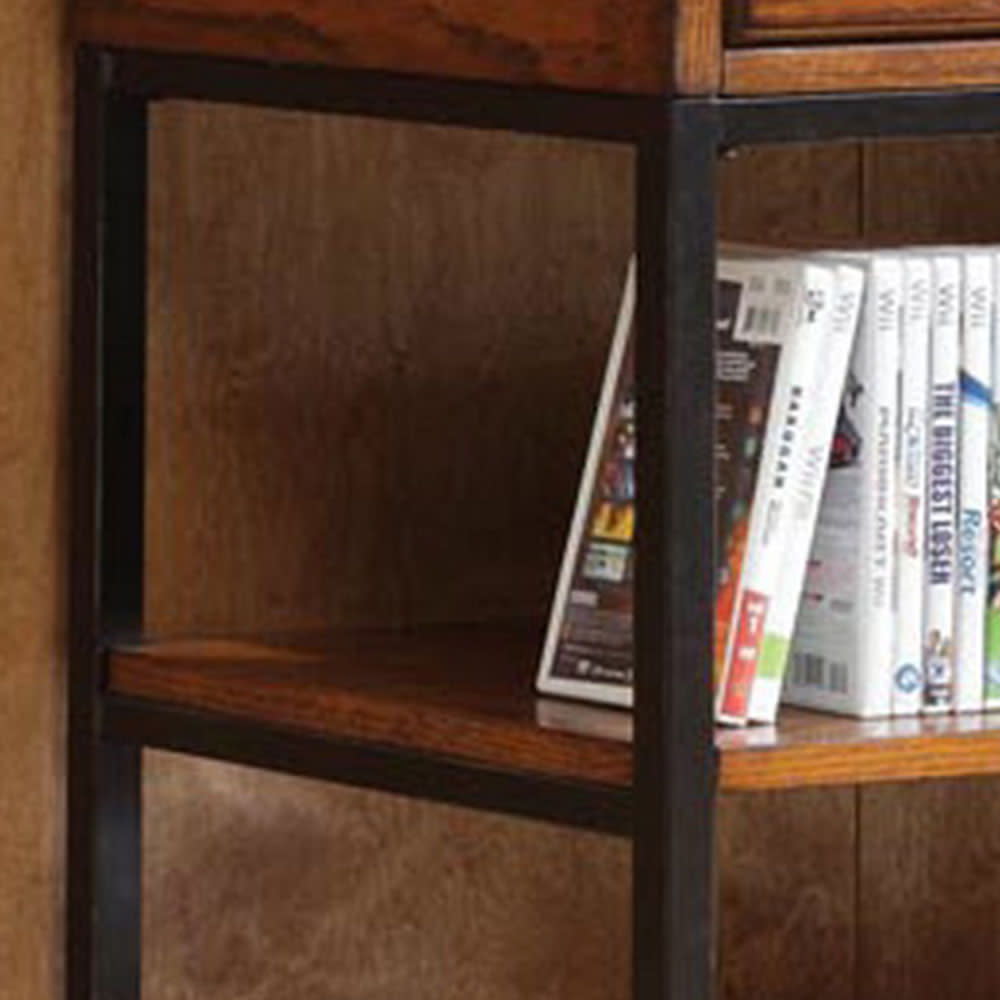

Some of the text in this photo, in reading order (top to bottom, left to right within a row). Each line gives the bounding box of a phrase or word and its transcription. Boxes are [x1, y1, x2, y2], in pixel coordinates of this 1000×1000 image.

[879, 289, 896, 332] Wii
[910, 278, 928, 320] Wii
[938, 283, 955, 326] Wii
[970, 286, 987, 328] Wii
[930, 384, 954, 586] THE BIGGEST LOSER
[960, 509, 980, 595] Resort
